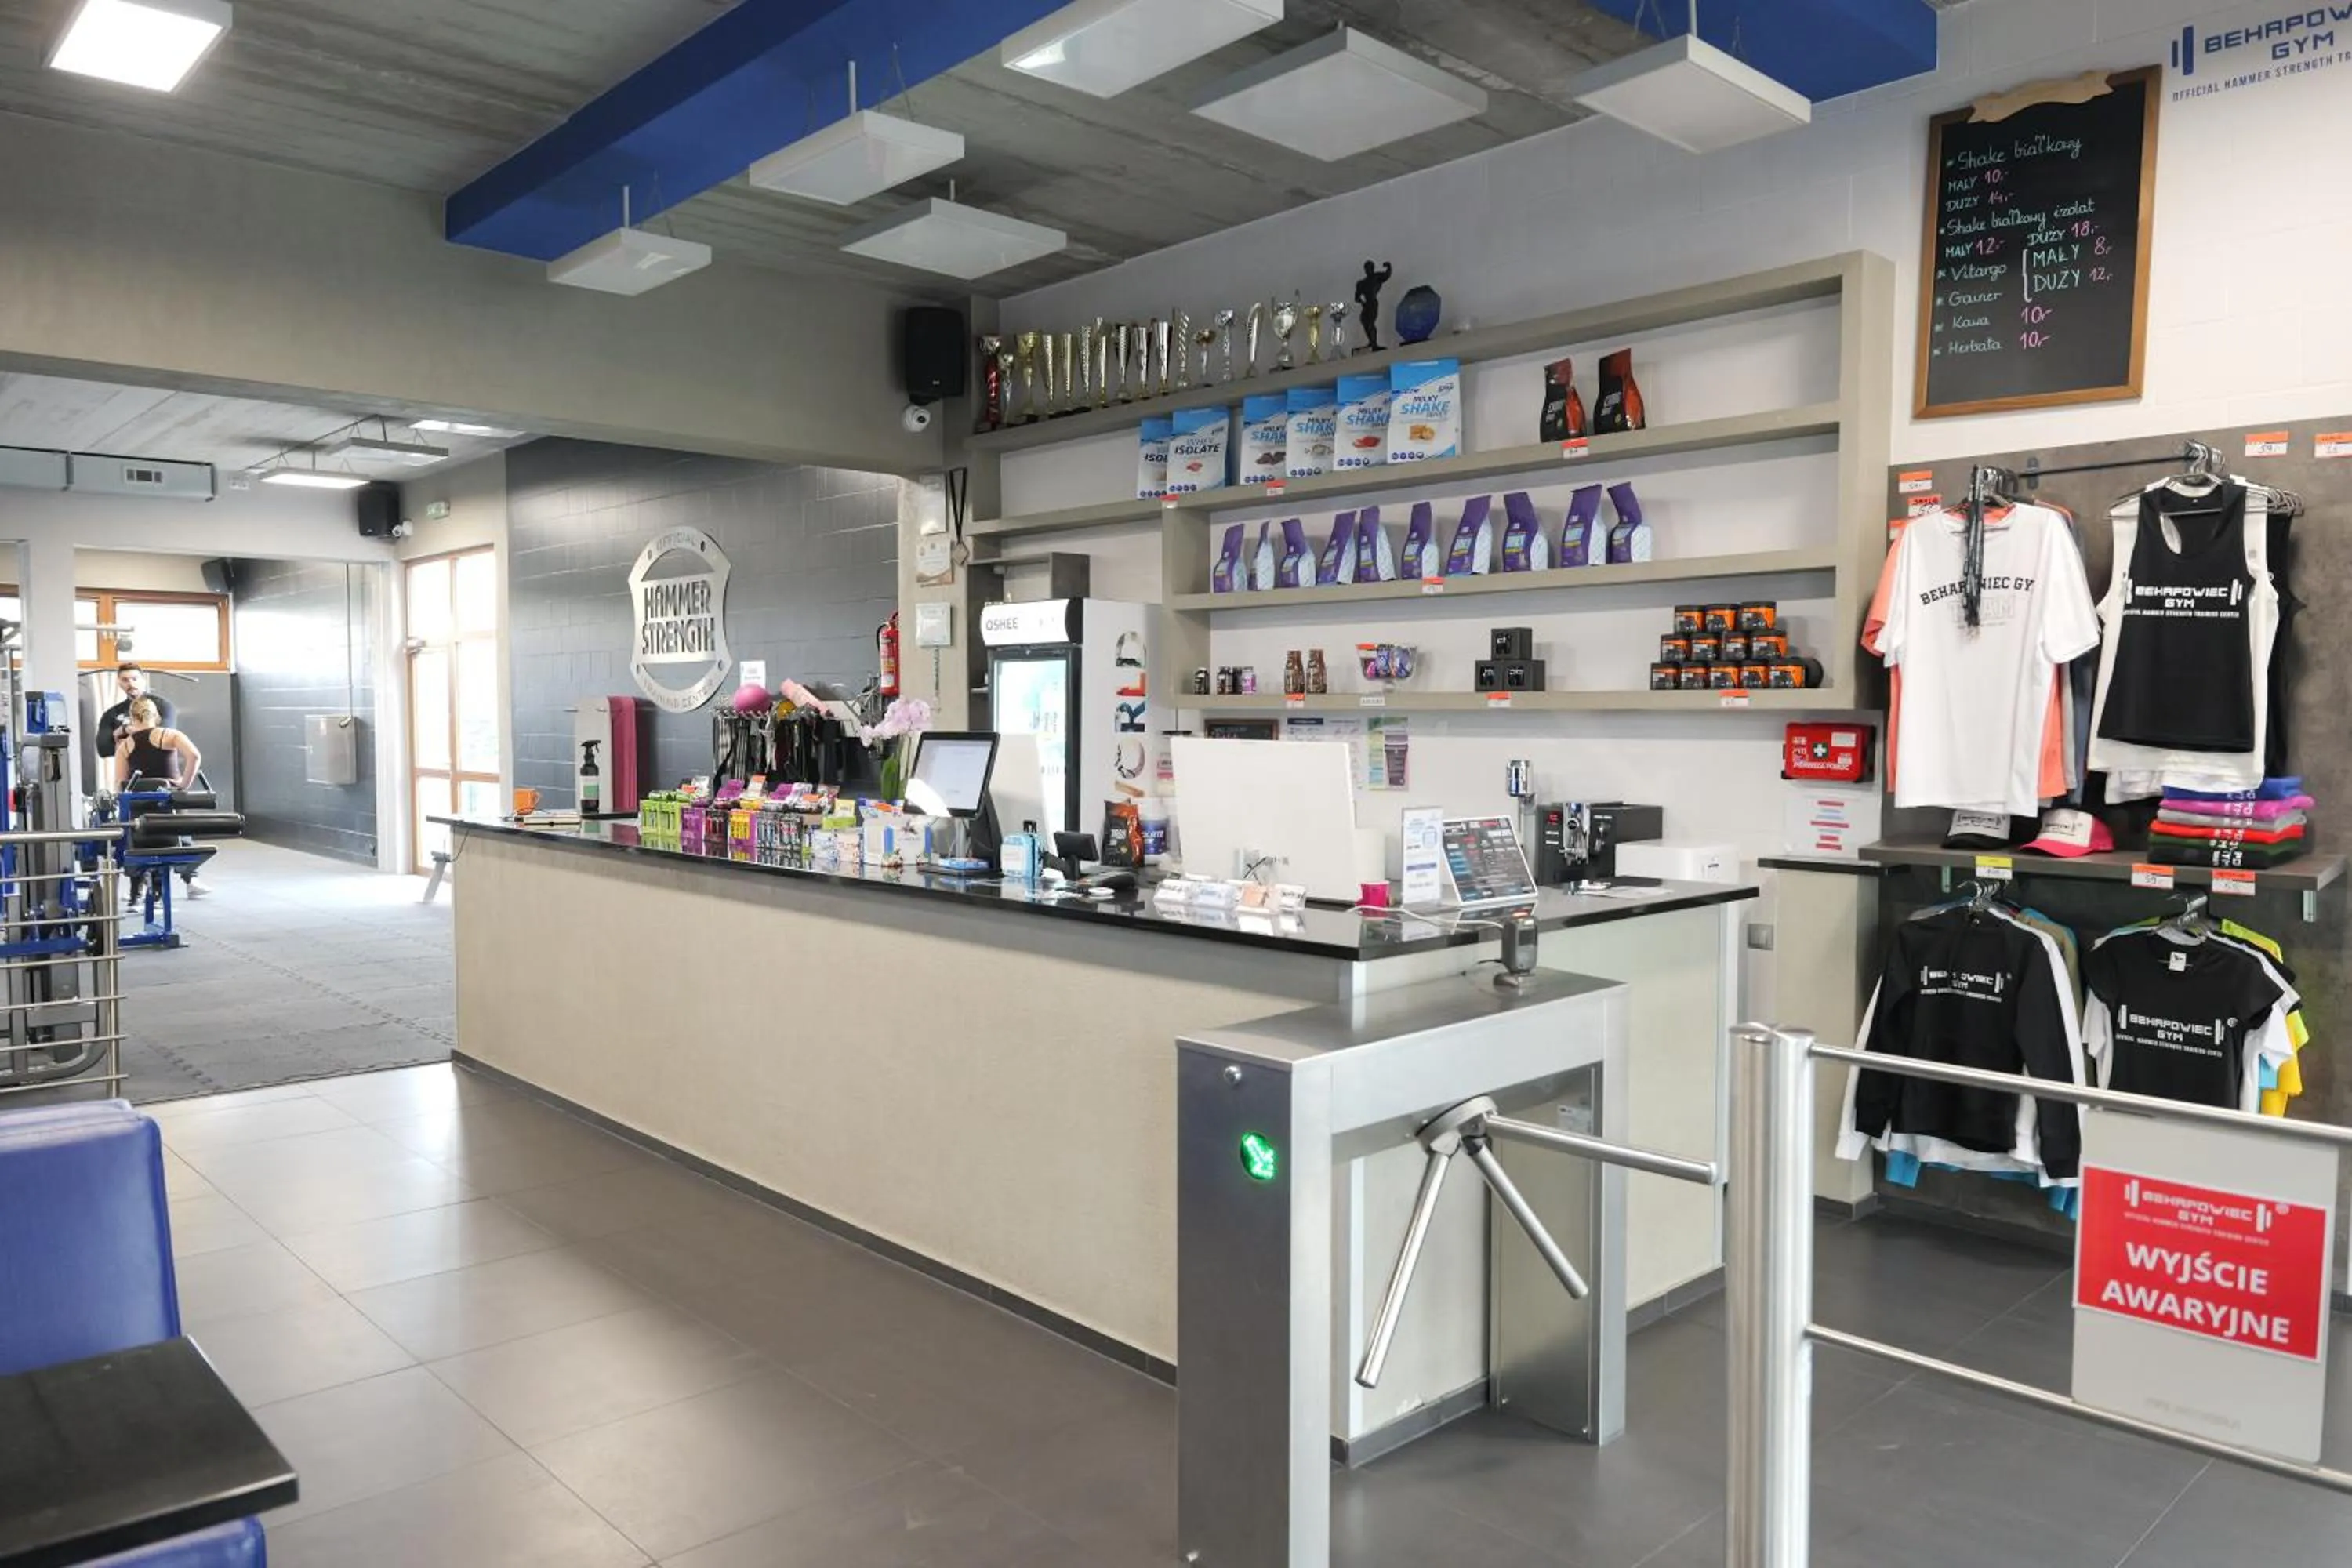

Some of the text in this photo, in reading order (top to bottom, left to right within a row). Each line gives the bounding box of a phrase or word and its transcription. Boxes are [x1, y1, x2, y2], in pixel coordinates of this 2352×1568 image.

[2272, 31, 2334, 60] GYM
[2172, 83, 2220, 102] OFFICIAL
[2224, 70, 2270, 89] HAMMER
[2275, 53, 2332, 78] STRENGTH
[1958, 146, 2006, 170] Shake
[1947, 216, 1986, 235] Shake
[2053, 197, 2095, 219] izolat
[2032, 244, 2080, 268] MAŁY
[1951, 263, 2007, 281] Vitargo
[2032, 269, 2080, 292] DUŻY
[1948, 291, 2002, 307] Gainer
[1952, 316, 1990, 328] Kawa
[1948, 338, 2002, 354] Herbata
[1400, 401, 1450, 414] SHAKE
[1295, 422, 1336, 435] SHAK
[1174, 445, 1221, 455] ISOLATE
[644, 581, 711, 619] HAMMER
[2135, 586, 2229, 597] BEHAPOWIEC
[2165, 598, 2195, 608] GYM
[985, 618, 1018, 631] OSHEE
[642, 617, 715, 655] STRENGTH
[2129, 1014, 2213, 1036] BEHAPOWIEC
[2157, 1029, 2183, 1042] GYM
[2178, 1210, 2214, 1226] GYM
[2125, 1242, 2269, 1296] WYJŚCIE
[2101, 1279, 2290, 1344] AWARYJNE
